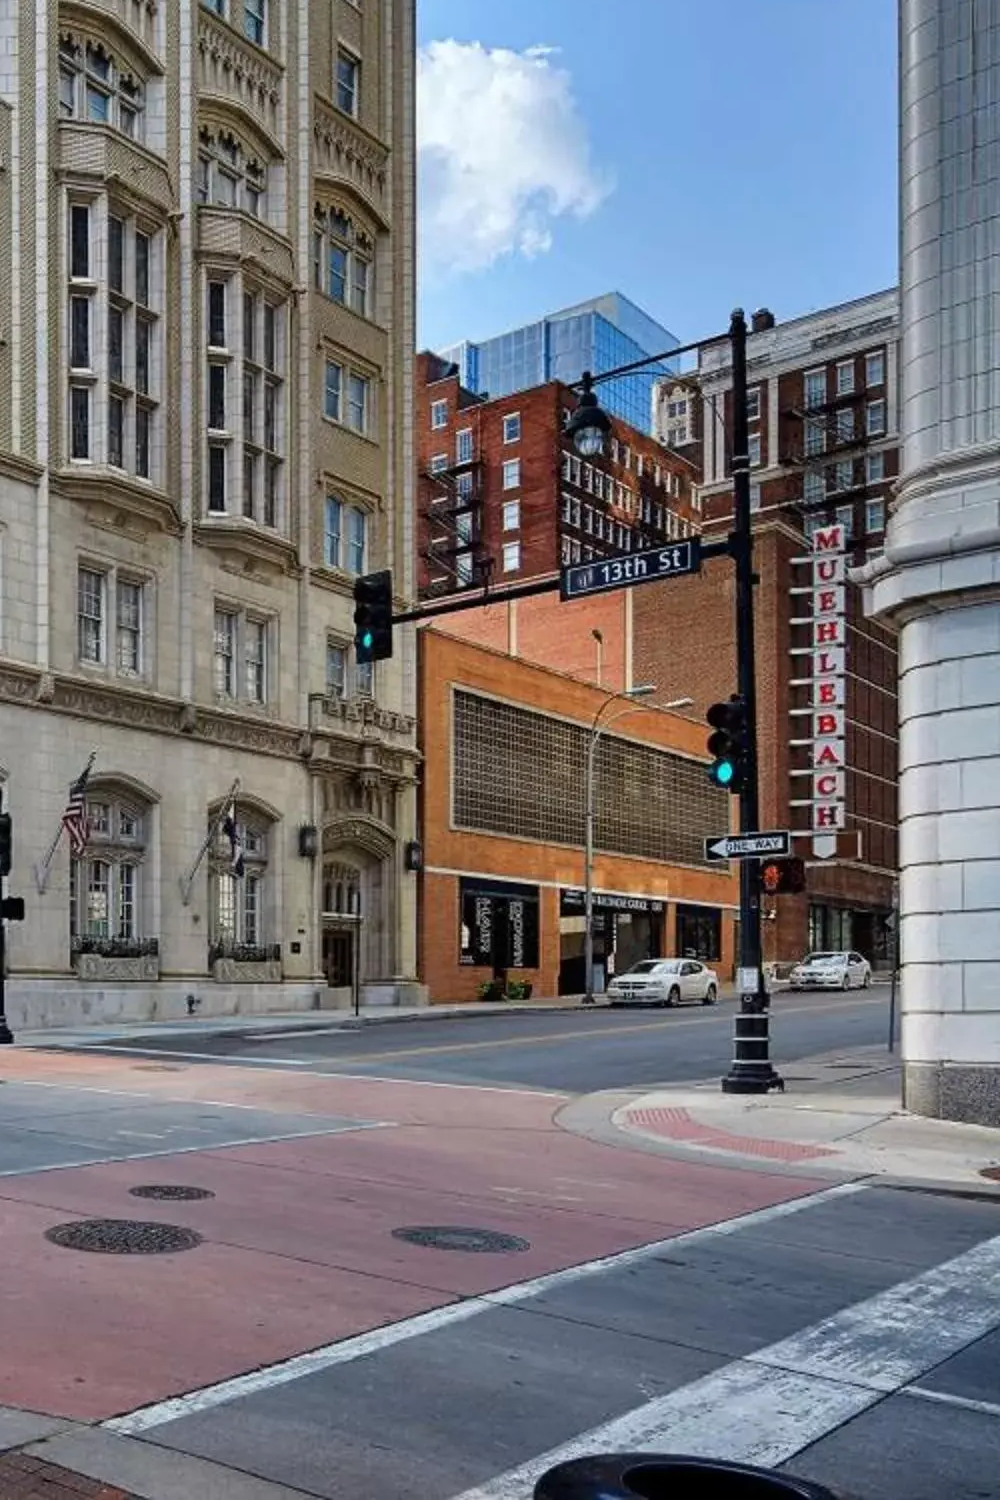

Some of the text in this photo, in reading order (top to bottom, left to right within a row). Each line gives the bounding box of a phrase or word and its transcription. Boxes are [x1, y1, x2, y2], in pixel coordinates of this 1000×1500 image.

[602, 549, 681, 583] 13th St
[815, 527, 841, 827] MUEHLEBACH
[725, 837, 779, 853] ONE WAY
